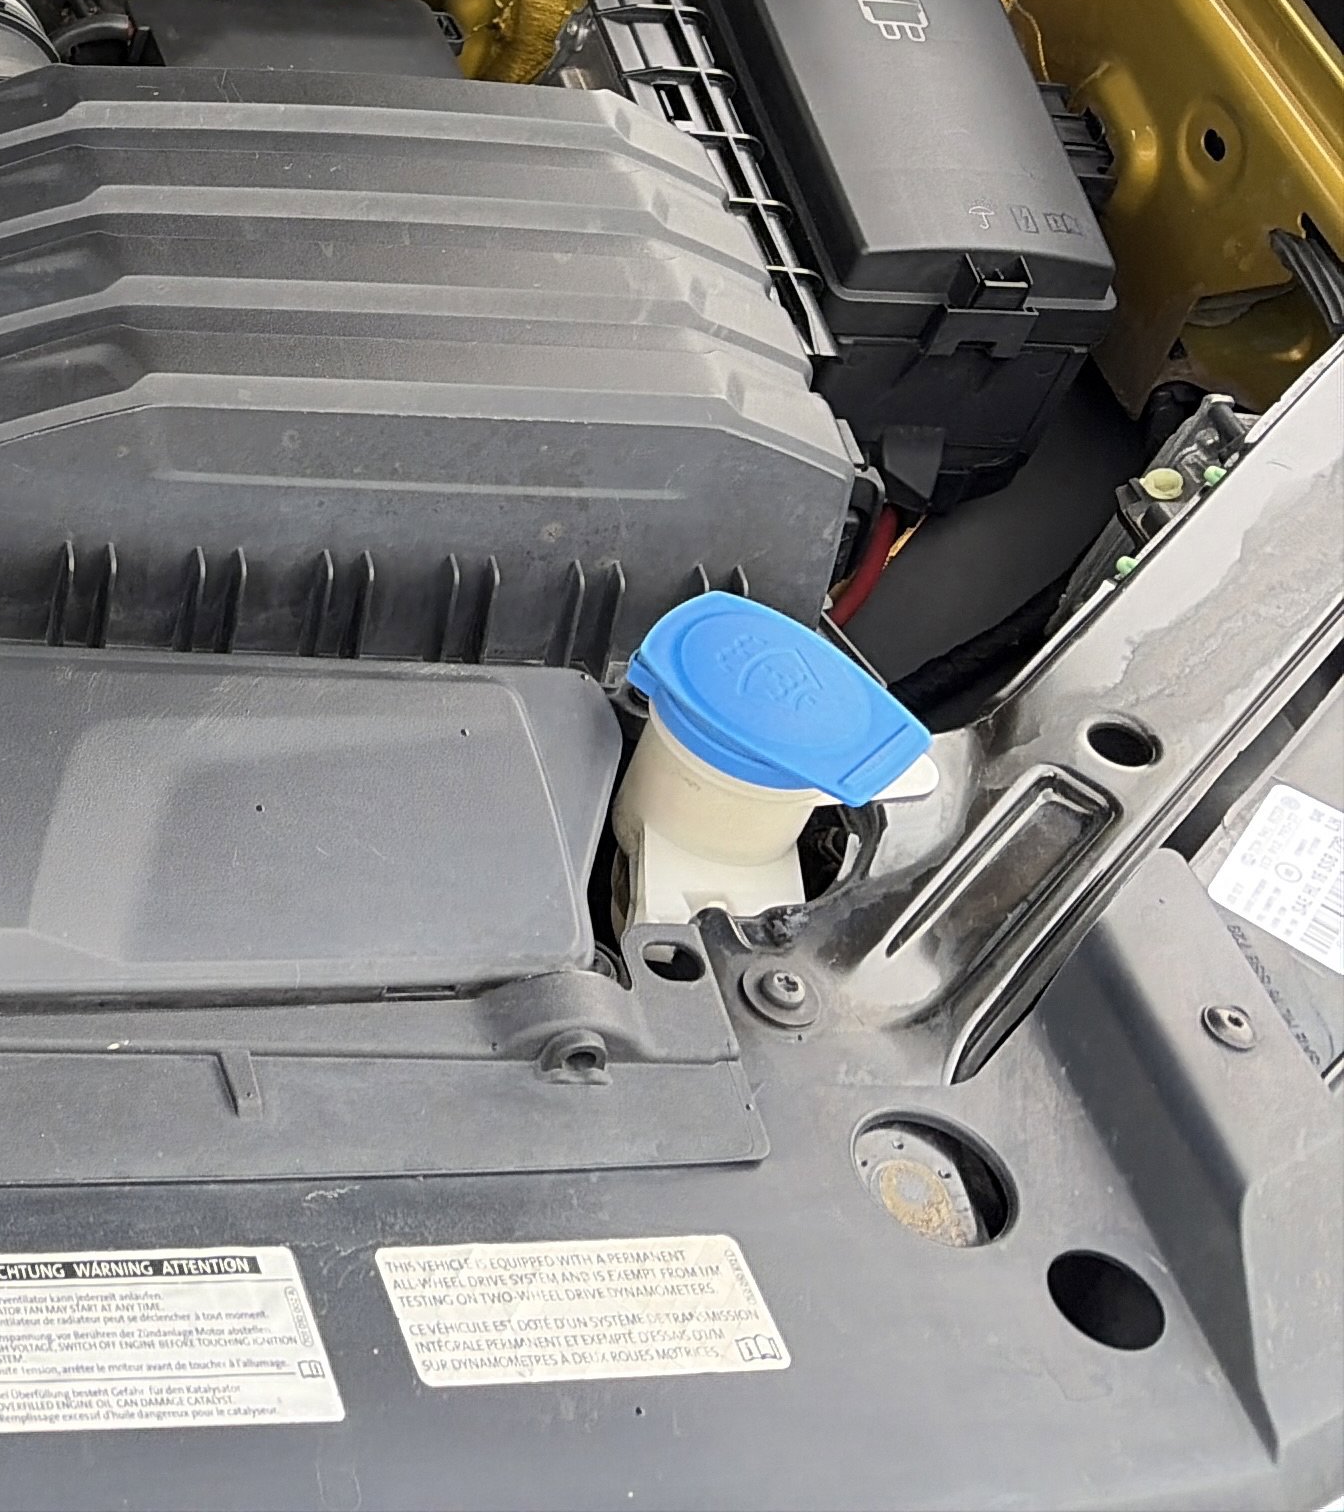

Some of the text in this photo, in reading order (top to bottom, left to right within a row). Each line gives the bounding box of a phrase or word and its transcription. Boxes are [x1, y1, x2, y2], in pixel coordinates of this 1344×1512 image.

[73, 1261, 153, 1277] WARNING
[162, 1257, 250, 1275] ATTENTION
[385, 1250, 686, 1273] THIS VEHICLE IS EQUIPPED WITH A PERMANENT
[393, 1277, 467, 1290] ALL-WHEEL
[468, 1274, 508, 1288] DRIVE
[509, 1272, 559, 1286] SYSTEM
[561, 1271, 590, 1283] AND
[593, 1270, 605, 1282] IS
[607, 1268, 656, 1282] EXEMPT
[660, 1267, 697, 1279] FROM
[398, 1294, 453, 1308] TESTING
[456, 1293, 478, 1306] ON
[479, 1290, 564, 1304] TWO-WHEEL
[565, 1288, 605, 1301] DRIVE
[24, 1307, 43, 1315] FAN
[45, 1305, 68, 1314] MAY
[70, 1303, 99, 1314] START
[101, 1303, 112, 1312] AT
[115, 1303, 134, 1313] ANY
[409, 1323, 427, 1336] CE
[426, 1320, 491, 1335] VÉHICULE
[493, 1318, 515, 1332] EST
[517, 1315, 551, 1331] DOTÉ
[553, 1316, 588, 1330] D'UN
[646, 1313, 664, 1325] DE
[664, 1309, 760, 1324] TRANSMISSION
[485, 1336, 562, 1350] PERMANENT
[564, 1334, 580, 1348] ET
[421, 1358, 448, 1372] SUR
[571, 1350, 608, 1365] DEUX
[610, 1348, 654, 1362] ROUES
[56, 1398, 93, 1410] ENGINE
[96, 1398, 112, 1409] OIL
[116, 1398, 139, 1408] CAN
[140, 1396, 184, 1407] DAMAGE
